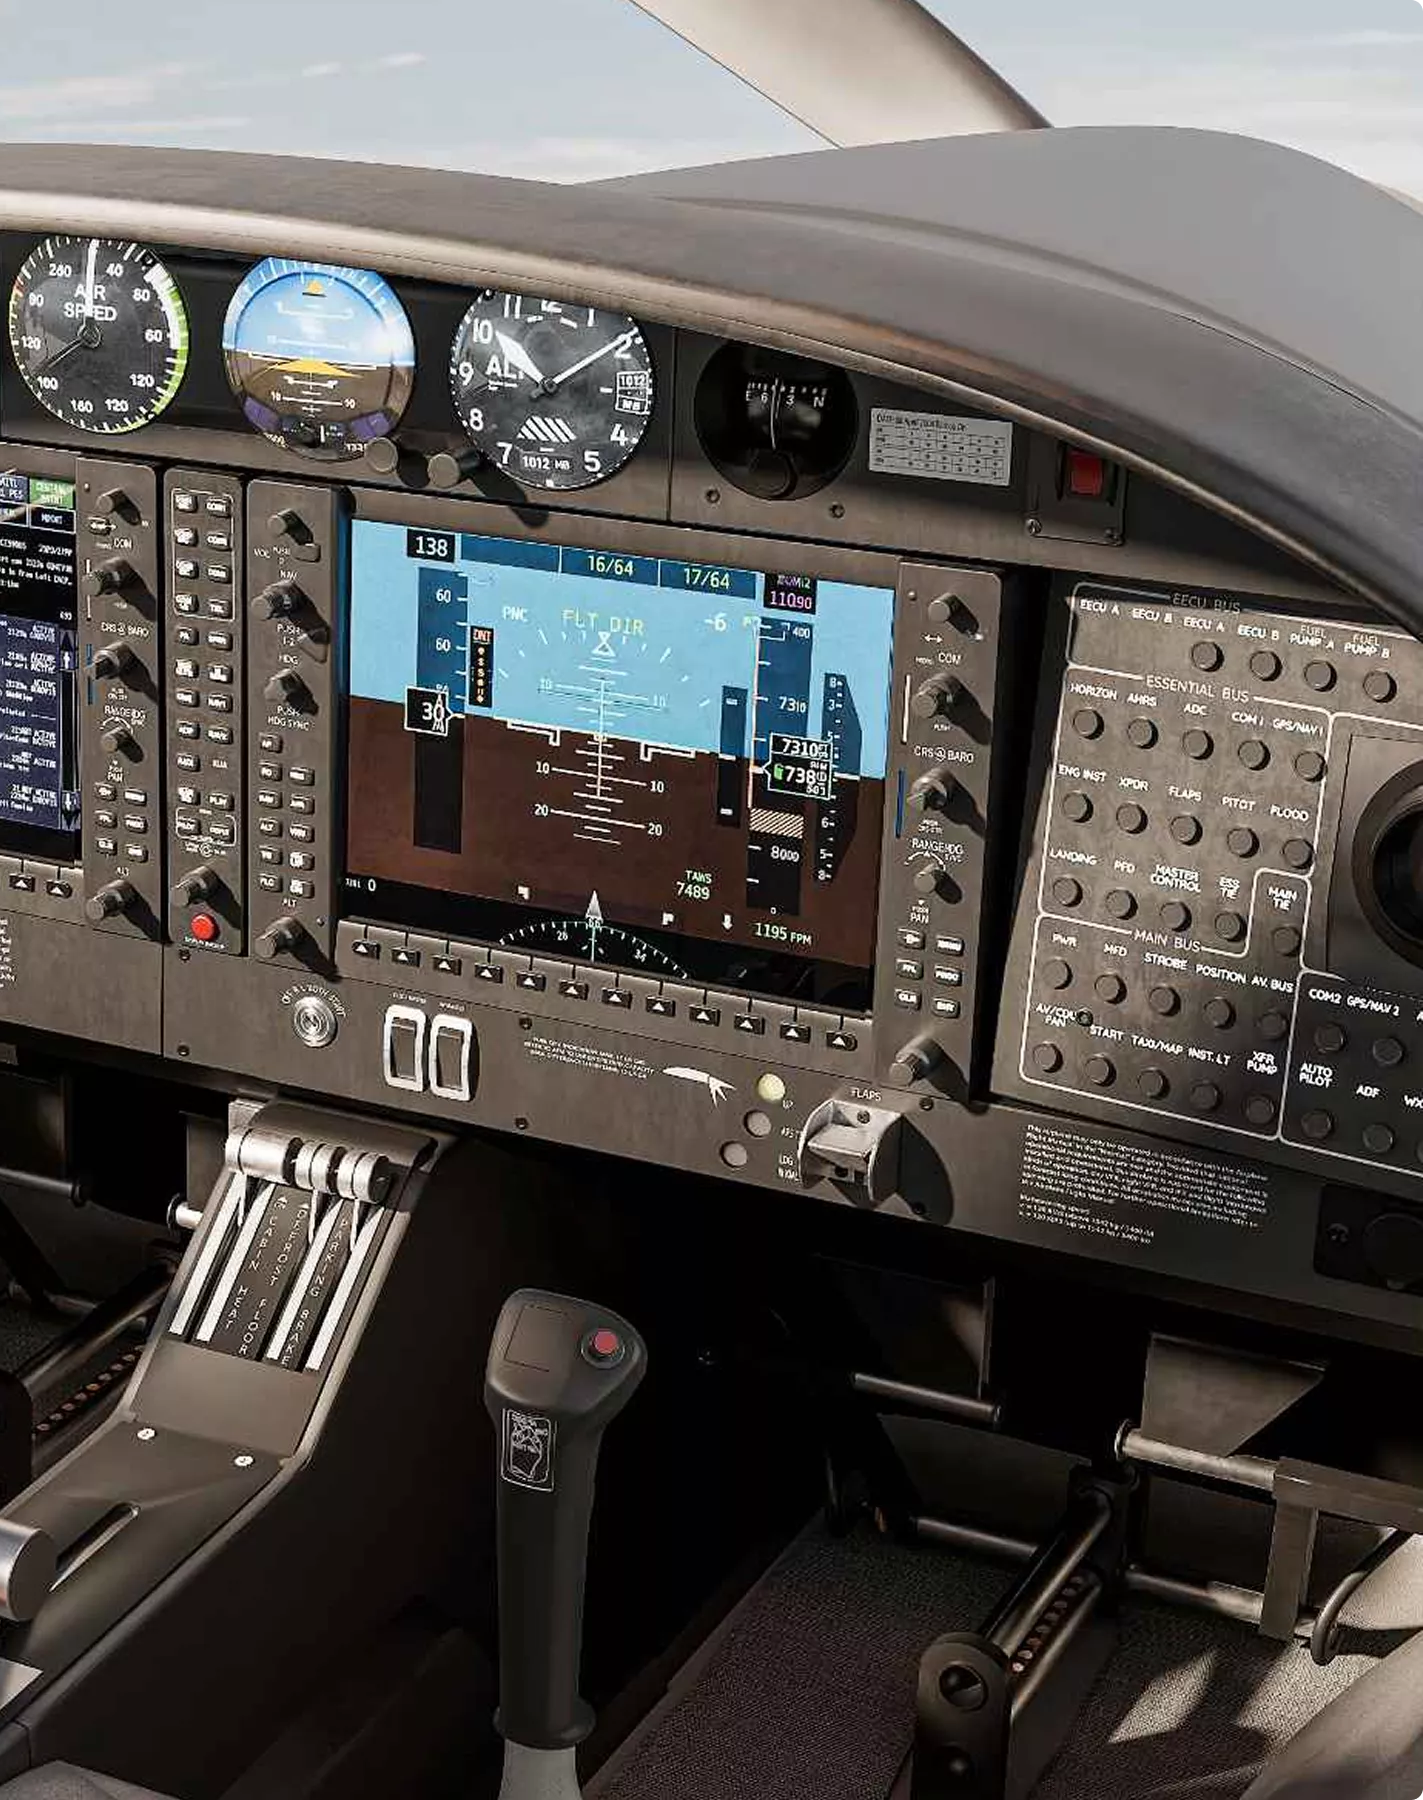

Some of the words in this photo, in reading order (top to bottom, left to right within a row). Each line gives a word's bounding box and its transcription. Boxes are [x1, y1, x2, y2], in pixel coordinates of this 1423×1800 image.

[106, 263, 124, 277] 40
[74, 284, 106, 301] AR
[145, 328, 163, 343] 60
[472, 318, 493, 344] 10
[458, 361, 475, 386] 9
[485, 354, 524, 380] AL
[129, 373, 155, 388] 120
[620, 374, 646, 388] 1012
[105, 398, 129, 412] 120
[761, 391, 769, 405] 6
[786, 393, 795, 406] 3
[813, 396, 825, 408] N
[469, 408, 484, 431] 8
[610, 423, 628, 447] 4
[496, 441, 513, 465] 7
[584, 450, 601, 473] 5
[522, 456, 551, 471] 1012
[555, 458, 571, 471] MB
[415, 535, 449, 557] 138
[586, 554, 635, 578] 16/64
[683, 567, 732, 590] 17/64
[435, 589, 452, 603] 60
[1172, 592, 1208, 609] EECU
[1080, 599, 1107, 614] EECU
[1111, 604, 1120, 617] A
[1132, 608, 1160, 622] EECU
[562, 609, 599, 630] FLT
[608, 614, 645, 636] DIR
[1183, 616, 1212, 631] EECU
[1215, 621, 1225, 632] A
[1237, 624, 1267, 640] EECU
[1271, 630, 1280, 640] B
[1300, 624, 1327, 639] FUEL
[1289, 633, 1323, 649] PUMP
[1325, 639, 1335, 650] A
[1352, 633, 1381, 648] FUEL
[937, 652, 963, 666] COM
[1343, 643, 1378, 658] PUMP
[1380, 647, 1391, 659] B
[1069, 682, 1119, 701] HORIZON
[1146, 674, 1216, 698] ESSENTIAL
[1221, 687, 1250, 703] BUS
[1126, 692, 1158, 707] AHRS
[1182, 702, 1208, 716] ADC
[781, 737, 818, 758] 7310
[947, 750, 975, 764] BARO
[534, 761, 551, 775] 10
[1057, 762, 1082, 779] ENG
[1082, 768, 1108, 784] INST
[650, 779, 666, 793] 10
[1118, 776, 1151, 793] XPDR
[1168, 784, 1203, 802] FLAPS
[533, 803, 550, 818] 20
[1221, 796, 1257, 812] PITOT
[1269, 804, 1310, 823] FLOOD
[647, 822, 664, 837] 20
[770, 845, 800, 863] 8000
[1049, 848, 1099, 867] LANDING
[1113, 859, 1137, 875] PFD
[1155, 864, 1200, 883] MASTER
[366, 877, 378, 893] 0
[684, 869, 714, 886] TAWS
[1150, 873, 1202, 893] CONTROL
[1219, 876, 1241, 889] ESS
[676, 881, 711, 901] 7489
[1220, 887, 1238, 901] TIE
[1267, 886, 1299, 903] MAIN
[1272, 897, 1291, 912] TIE
[910, 913, 929, 924] PAN
[754, 921, 789, 942] 1195
[789, 931, 813, 947] FPM
[1051, 933, 1078, 948] PWR
[1133, 929, 1169, 948] MAIN
[1173, 936, 1202, 953] BUS
[1103, 942, 1129, 958] MFD
[1143, 952, 1189, 971] STROBE
[1195, 963, 1248, 985] POSITION
[1307, 987, 1343, 1005] COM2
[1346, 994, 1393, 1015] GPS/NAV
[1044, 1015, 1069, 1029] PAN
[1089, 1024, 1125, 1042] START
[1131, 1034, 1184, 1056] TAXI/MAP
[1251, 1050, 1276, 1066] XFR
[1246, 1059, 1278, 1076] PUMP
[1299, 1062, 1334, 1079] AUTO
[1298, 1071, 1334, 1089] PILOT
[1355, 1084, 1381, 1099] ADF
[249, 1216, 278, 1272] CABIN
[309, 1218, 349, 1298] PARKING
[226, 1284, 248, 1330] HEAT
[239, 1297, 268, 1356] FLOOR
[280, 1308, 311, 1366] BRAKE
